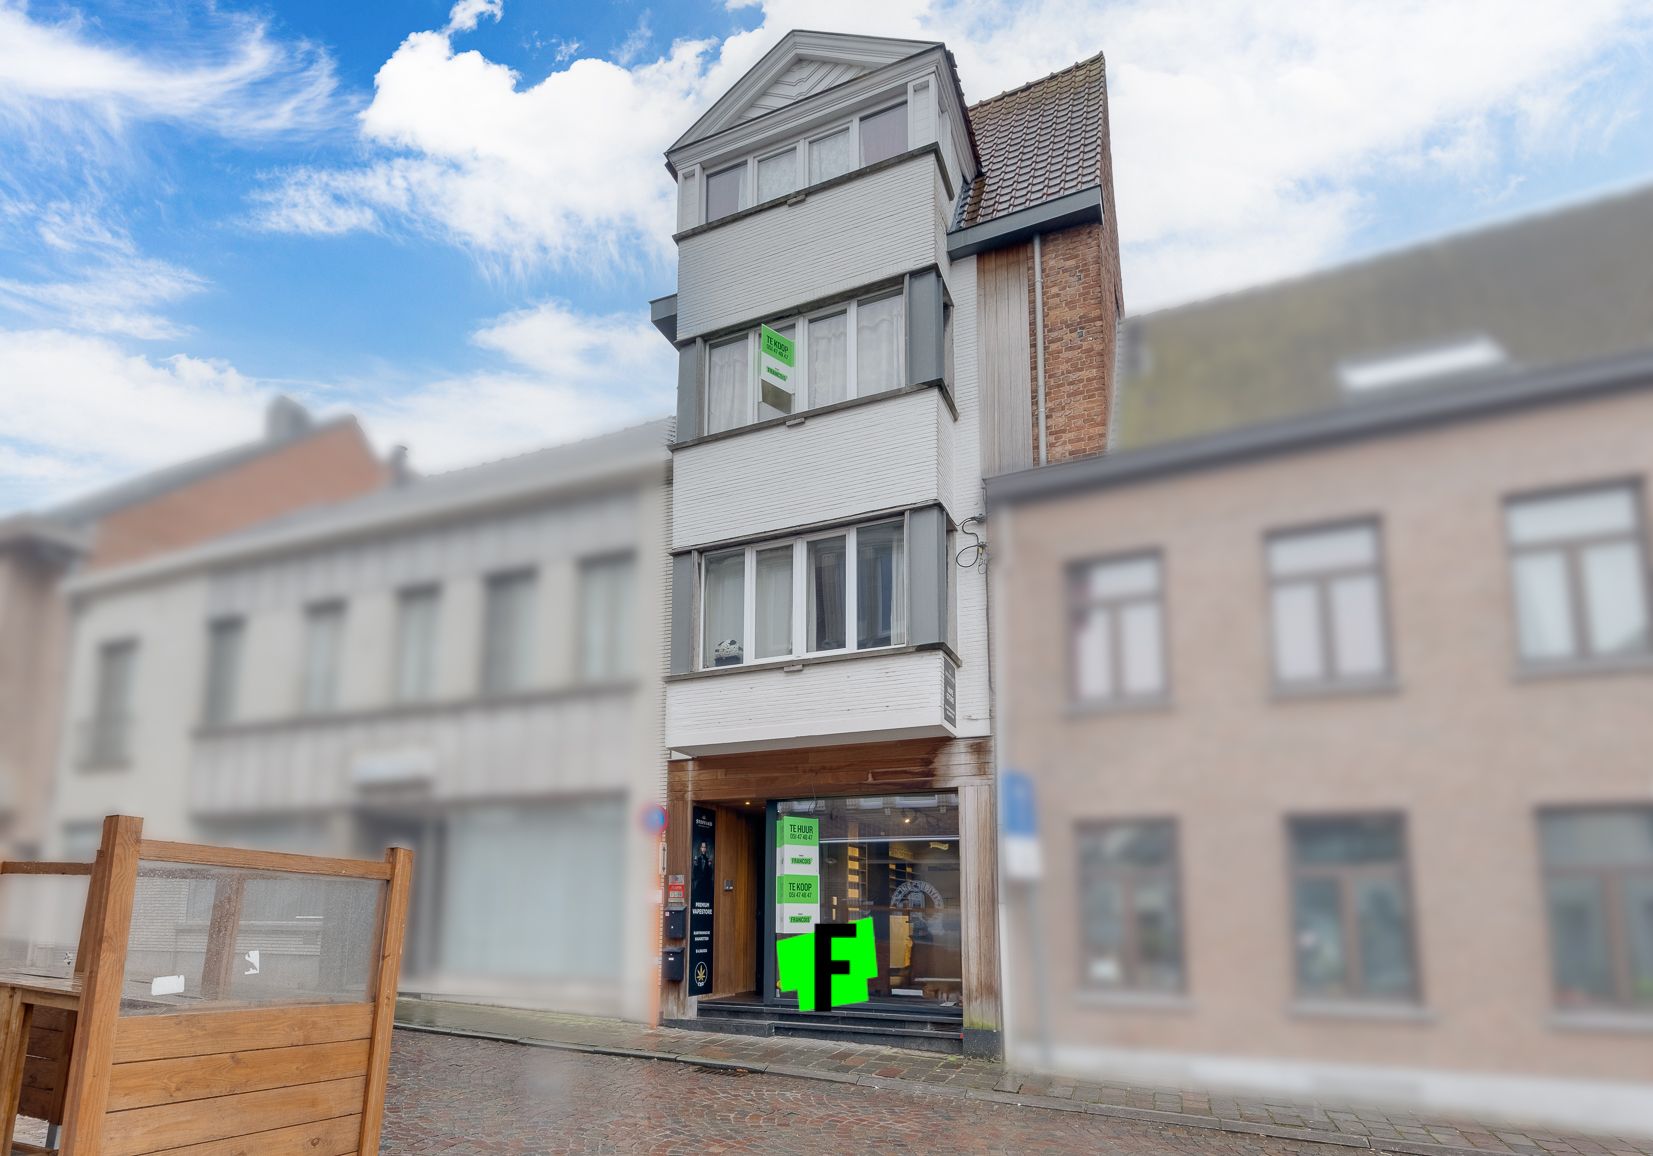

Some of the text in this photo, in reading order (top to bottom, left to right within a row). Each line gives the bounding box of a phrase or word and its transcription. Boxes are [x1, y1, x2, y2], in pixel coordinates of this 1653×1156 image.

[767, 335, 789, 353] TE KOOP
[790, 824, 814, 834] TE HUUR
[789, 882, 812, 892] TE KOOP
